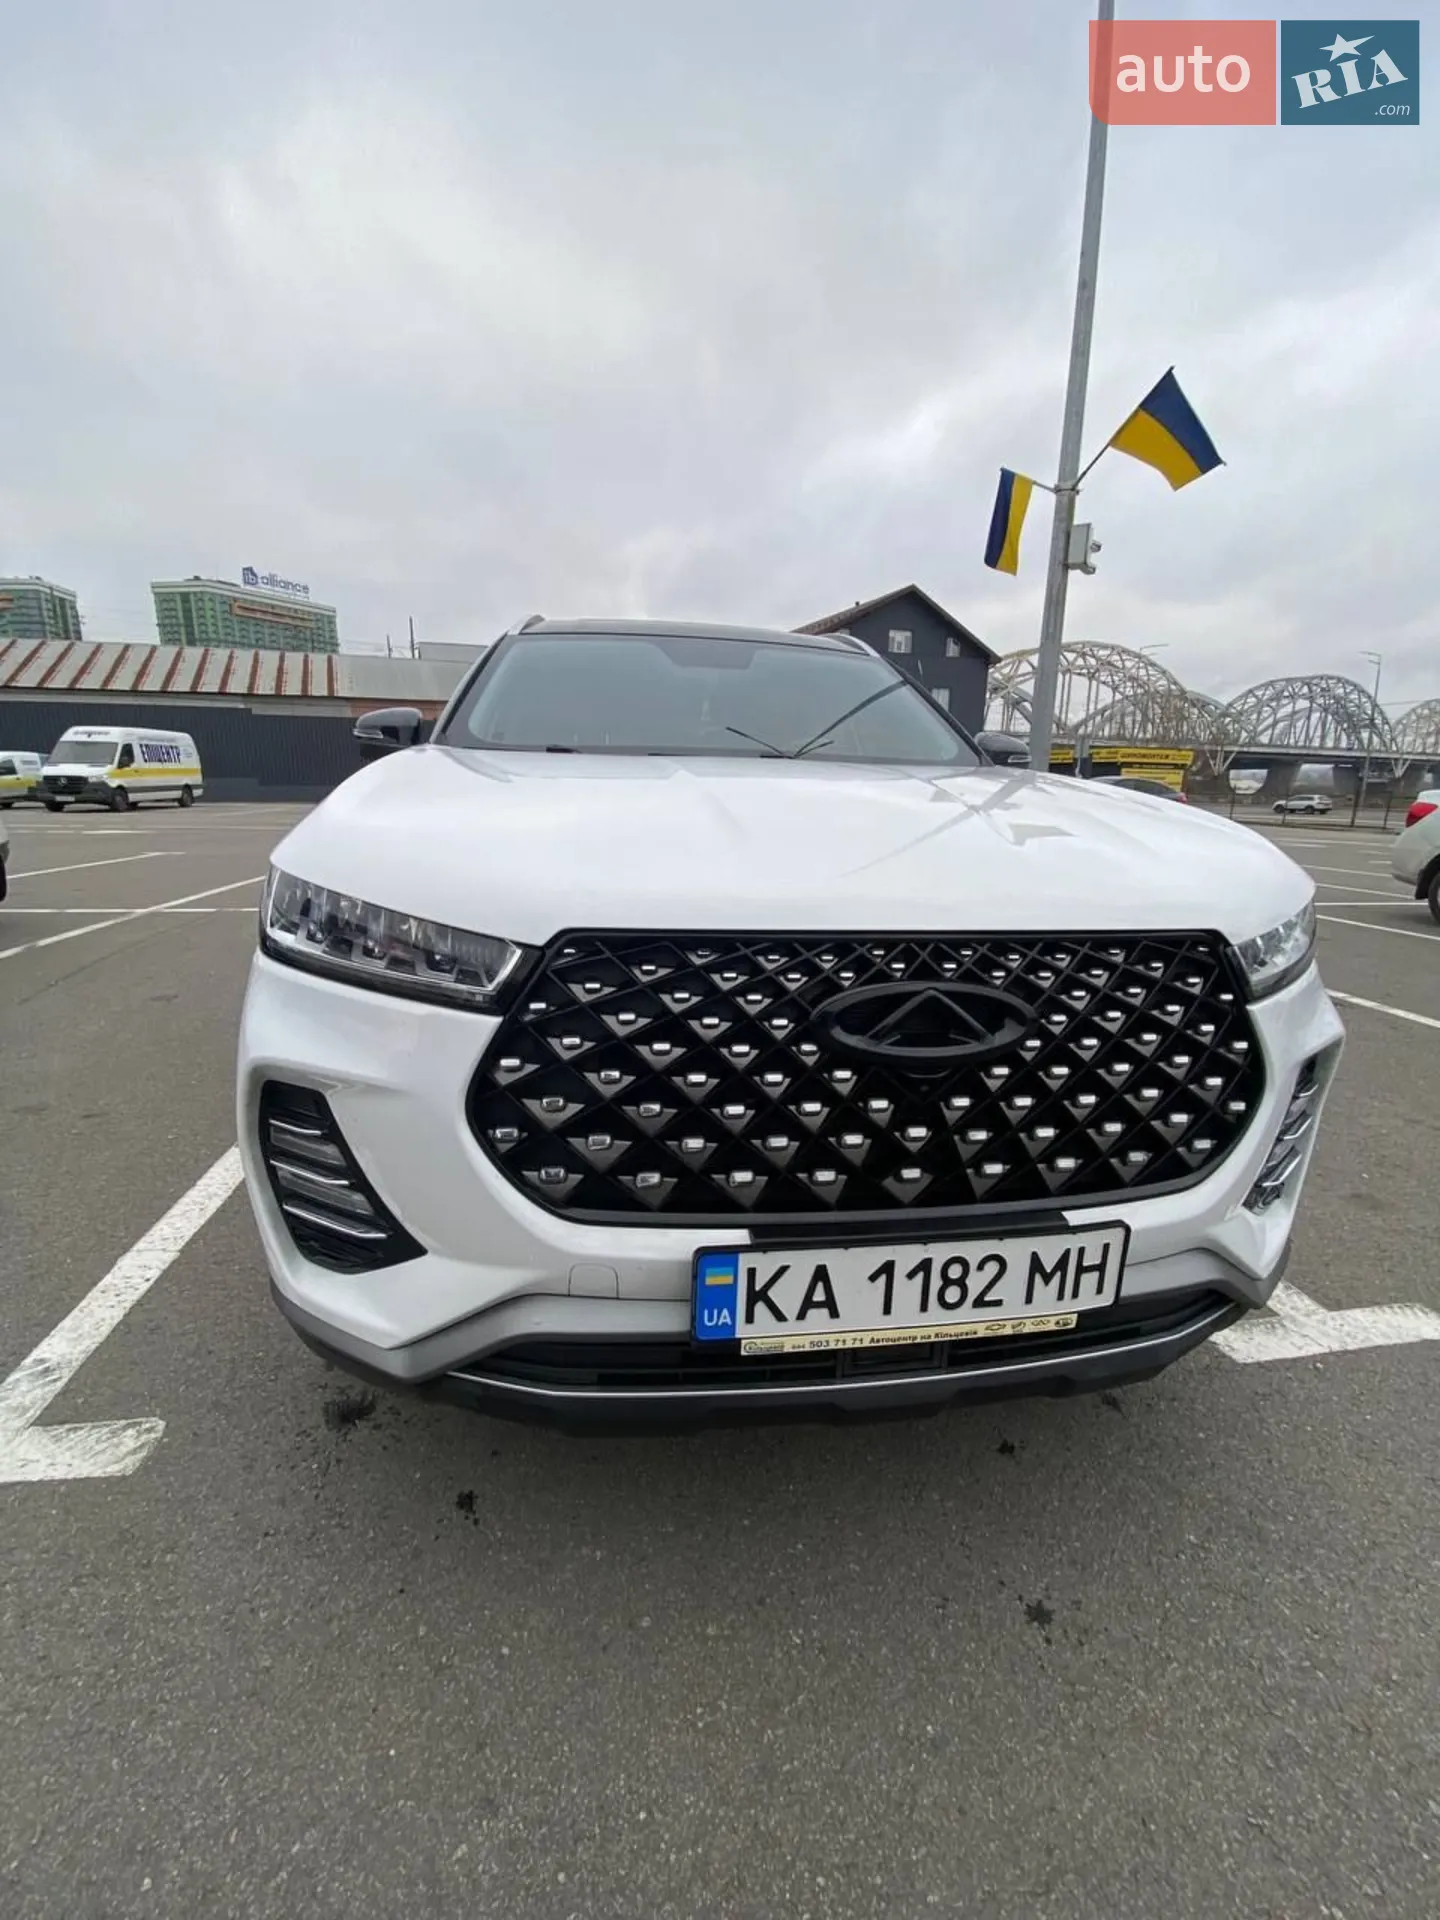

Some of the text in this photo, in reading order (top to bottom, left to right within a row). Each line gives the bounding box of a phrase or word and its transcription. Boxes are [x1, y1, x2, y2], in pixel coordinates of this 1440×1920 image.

[259, 572, 309, 594] alliance
[745, 1242, 1110, 1324] KA 1182 MH
[704, 1308, 732, 1326] UA
[809, 1339, 830, 1349] 503
[834, 1338, 847, 1347] 71
[851, 1337, 864, 1346] 71
[868, 1334, 918, 1345] Автоцентр
